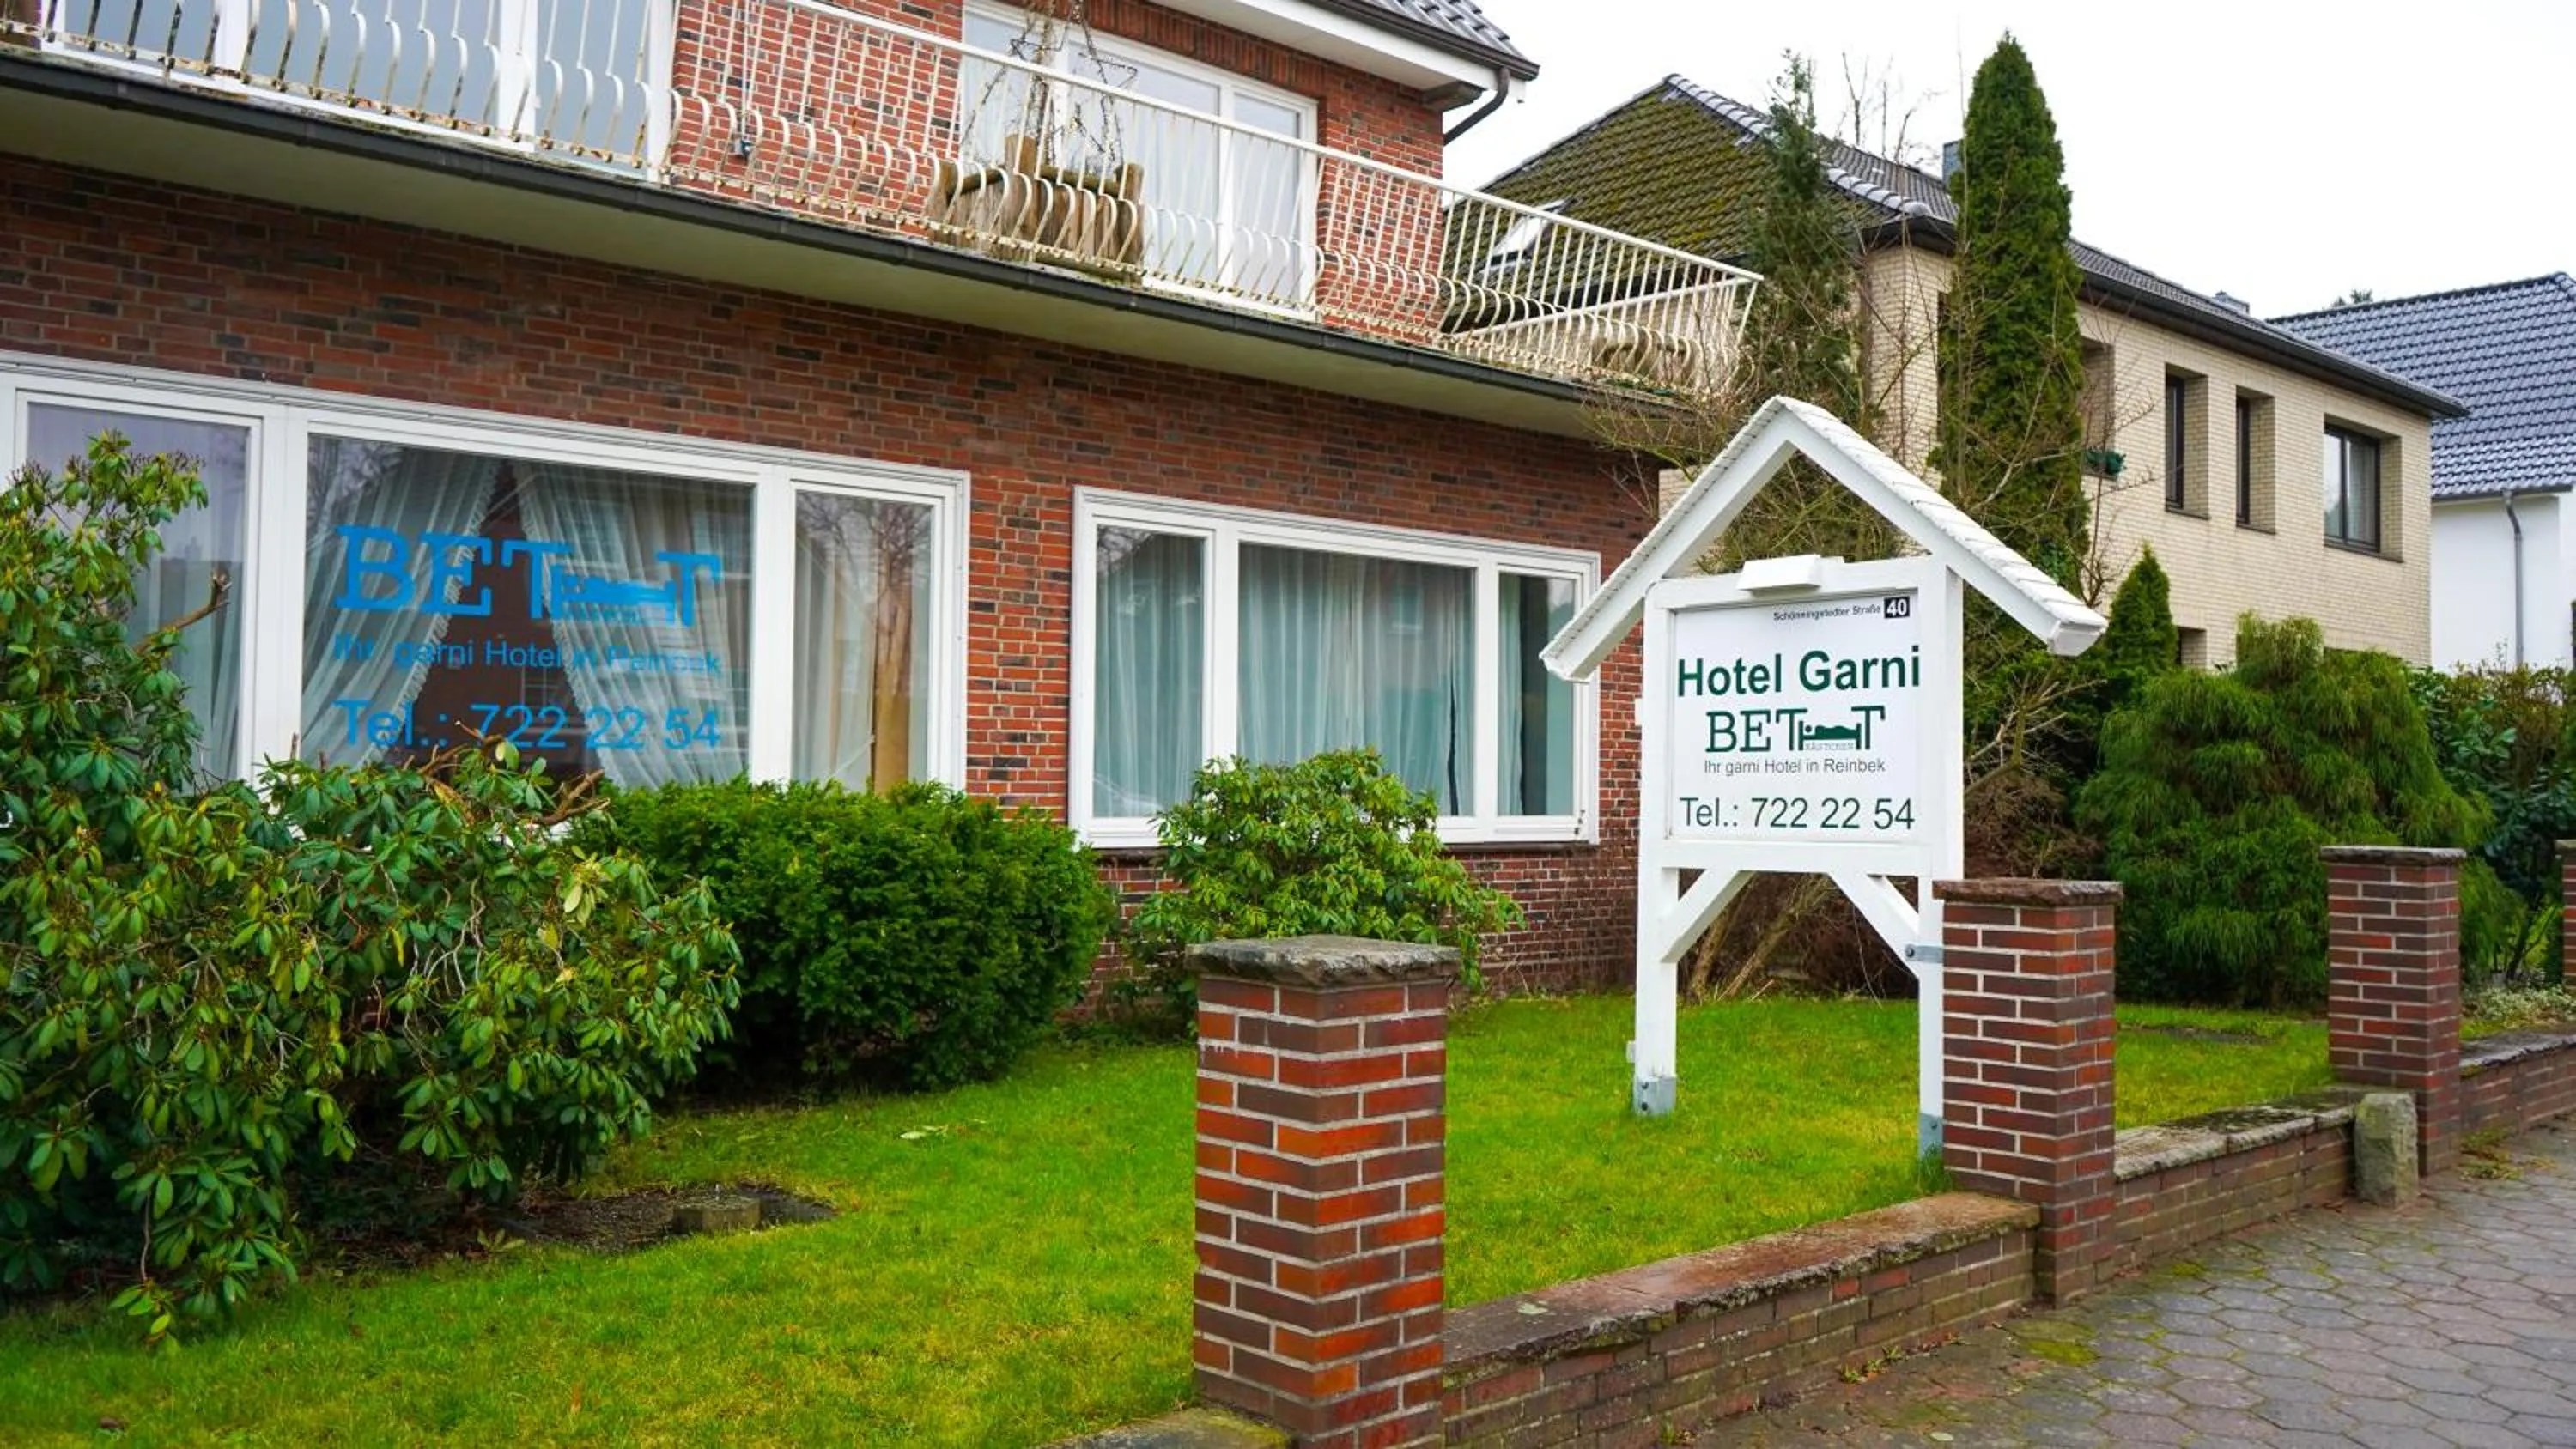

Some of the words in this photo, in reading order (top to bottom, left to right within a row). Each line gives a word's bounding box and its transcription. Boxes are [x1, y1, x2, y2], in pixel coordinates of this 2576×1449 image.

[1886, 598, 1907, 616] 40
[484, 638, 562, 668] Hotel
[1678, 653, 1782, 697] Hotel
[1799, 645, 1920, 692] Garni
[470, 703, 566, 749] 722
[585, 704, 647, 751] 22
[664, 706, 723, 751] 54
[1704, 760, 1721, 773] Ihr
[1725, 760, 1760, 777] garni
[1765, 759, 1801, 773] Hotel
[1806, 759, 1820, 773] in
[1824, 758, 1886, 773] Reinbek
[1679, 797, 1739, 827] Tel.:
[1751, 797, 1808, 828] 722
[1820, 797, 1861, 828] 22
[1874, 797, 1915, 830] 54
